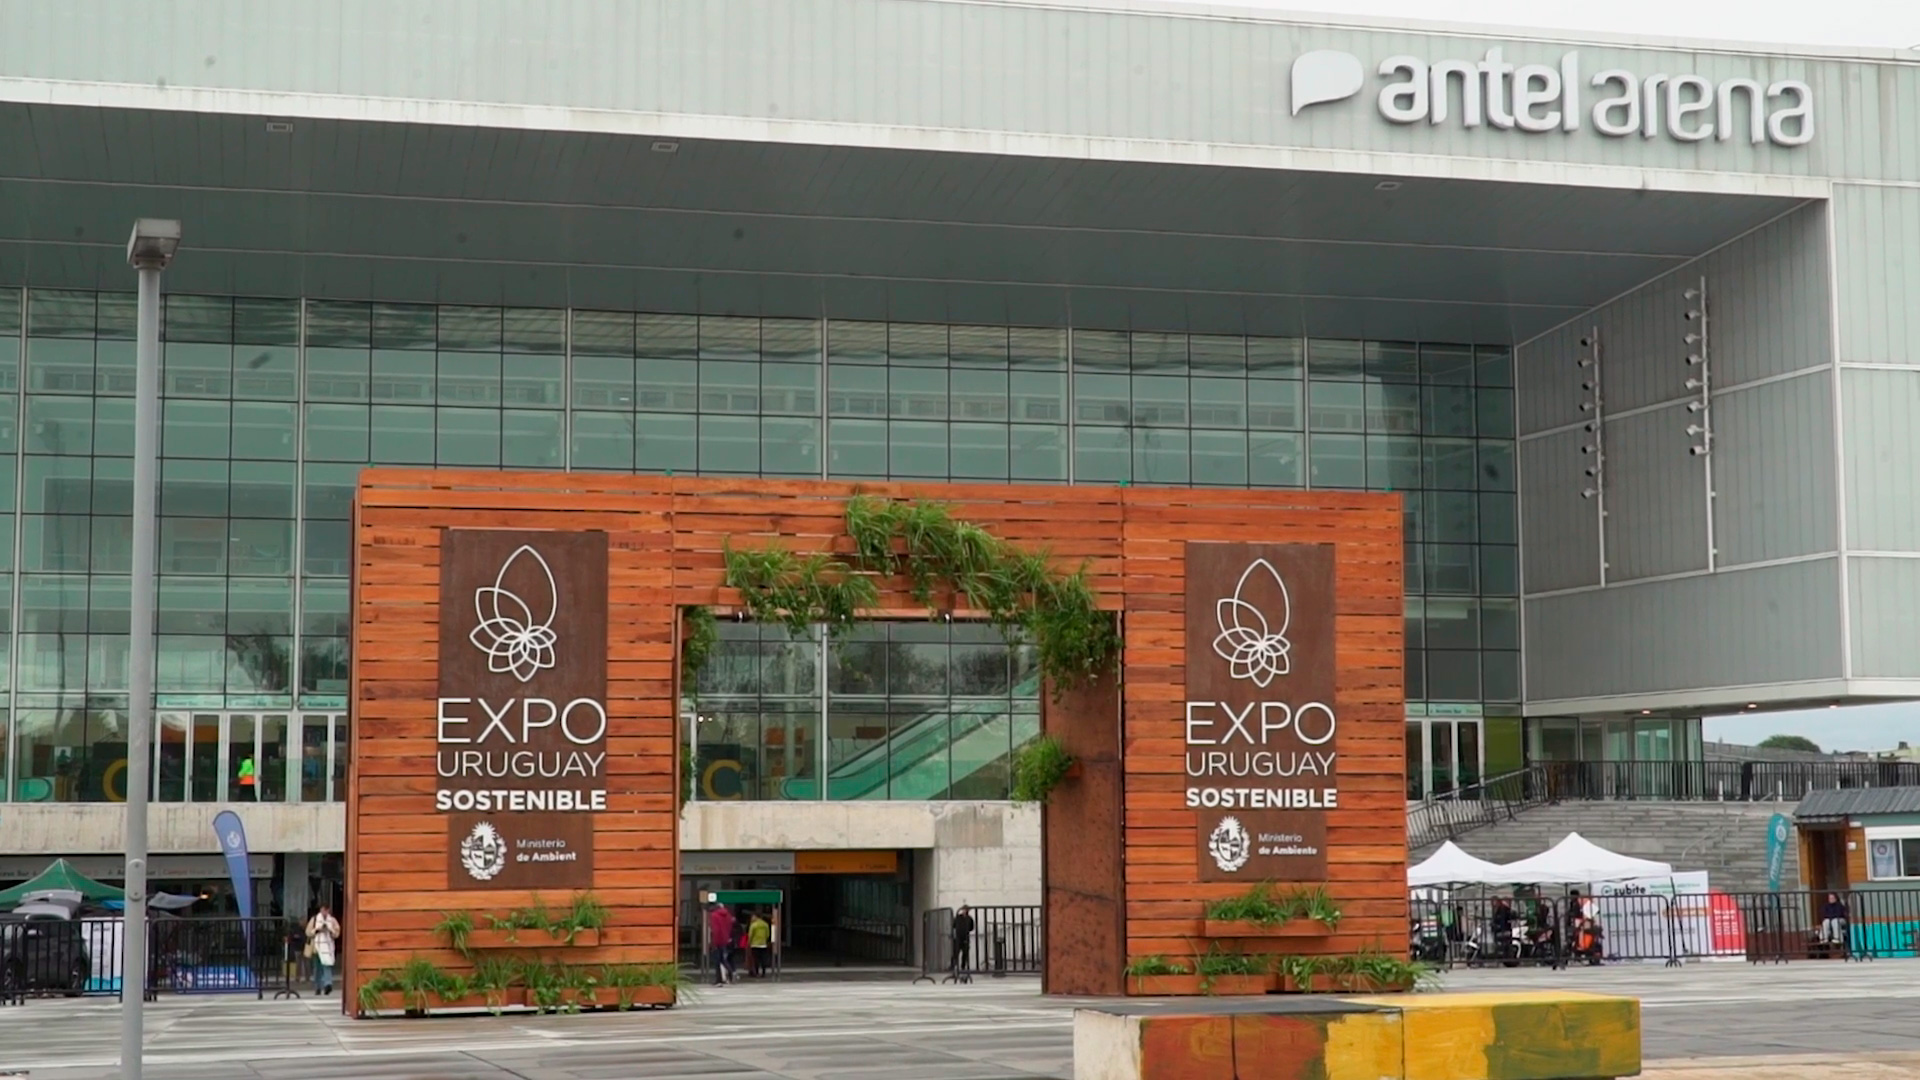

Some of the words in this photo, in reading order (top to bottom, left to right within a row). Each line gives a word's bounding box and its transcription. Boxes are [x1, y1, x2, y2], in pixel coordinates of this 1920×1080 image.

[1377, 46, 1579, 132] antel
[1591, 67, 1815, 147] arena
[437, 697, 607, 744] EXPO
[1186, 701, 1336, 745] EXPO
[437, 750, 606, 777] URUGUAY
[1186, 751, 1336, 776] URUGUAY
[436, 789, 607, 811] SOSTENIBLE
[1186, 788, 1338, 808] SOSTENIBLE
[516, 838, 566, 849] Ministerio
[1258, 833, 1303, 843] Ministerio
[516, 852, 529, 862] de
[1258, 846, 1270, 855] de
[1272, 844, 1318, 855] Ambiente
